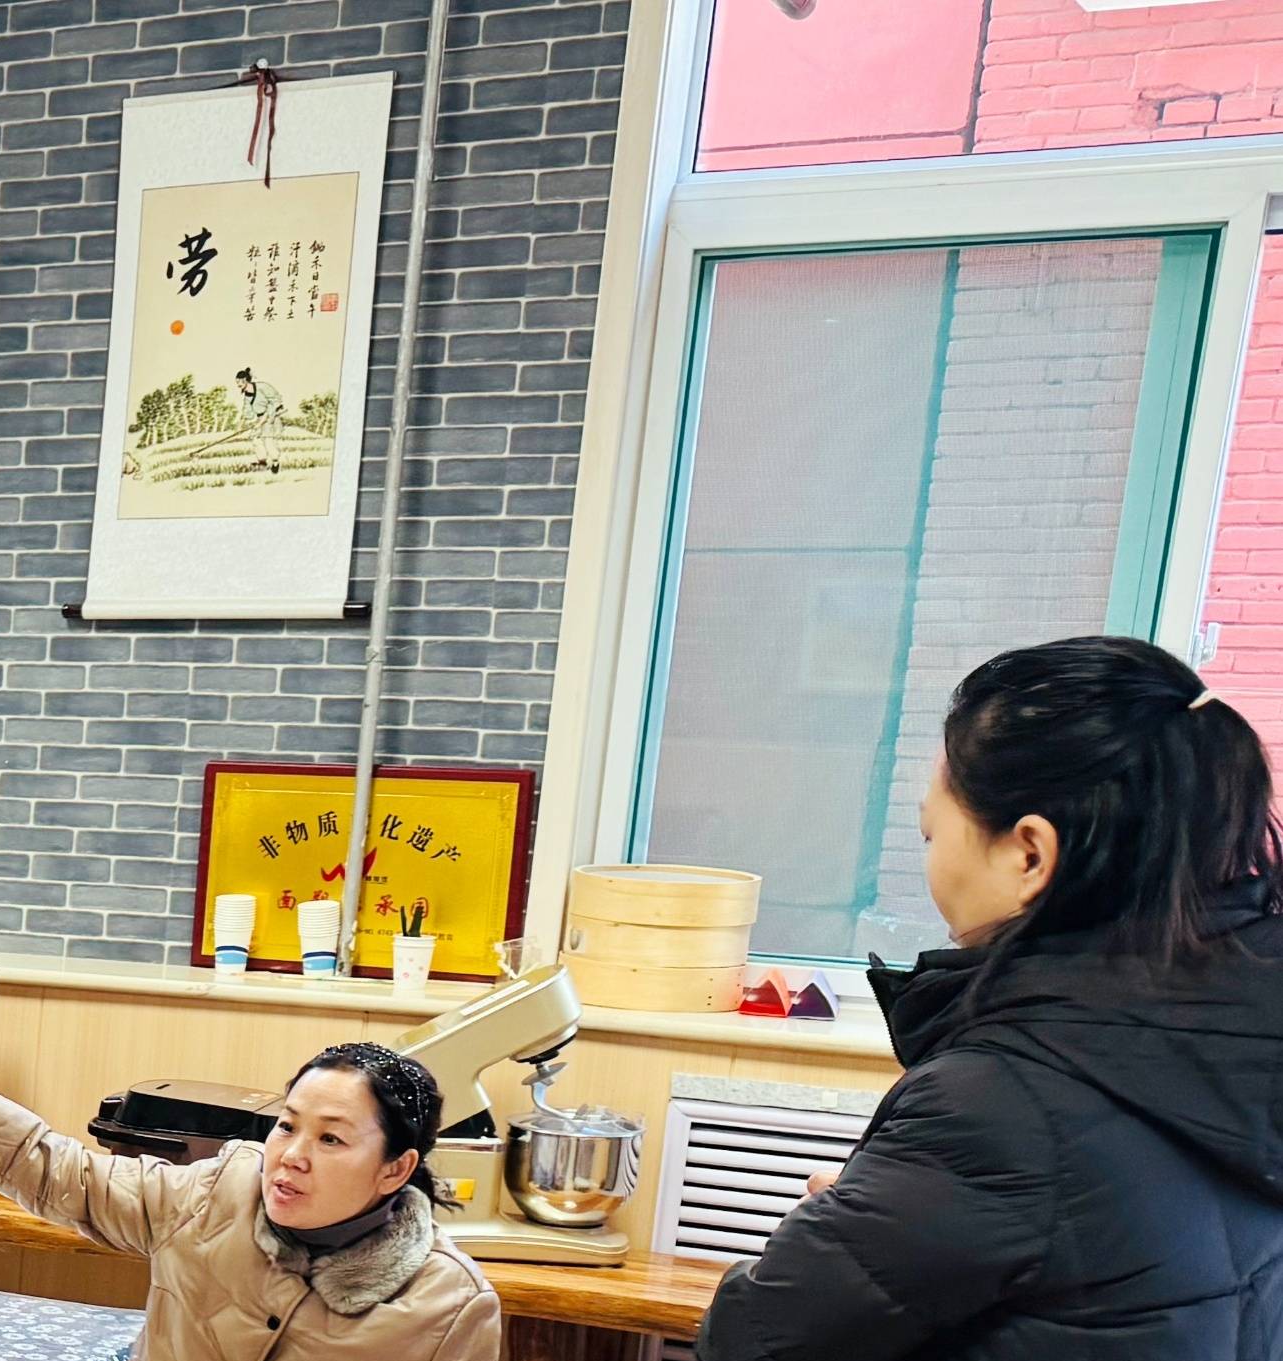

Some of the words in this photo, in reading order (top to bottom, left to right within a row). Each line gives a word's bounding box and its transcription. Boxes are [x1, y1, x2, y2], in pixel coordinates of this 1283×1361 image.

[166, 226, 219, 298] 劳
[257, 810, 462, 862] 非物质化遗产
